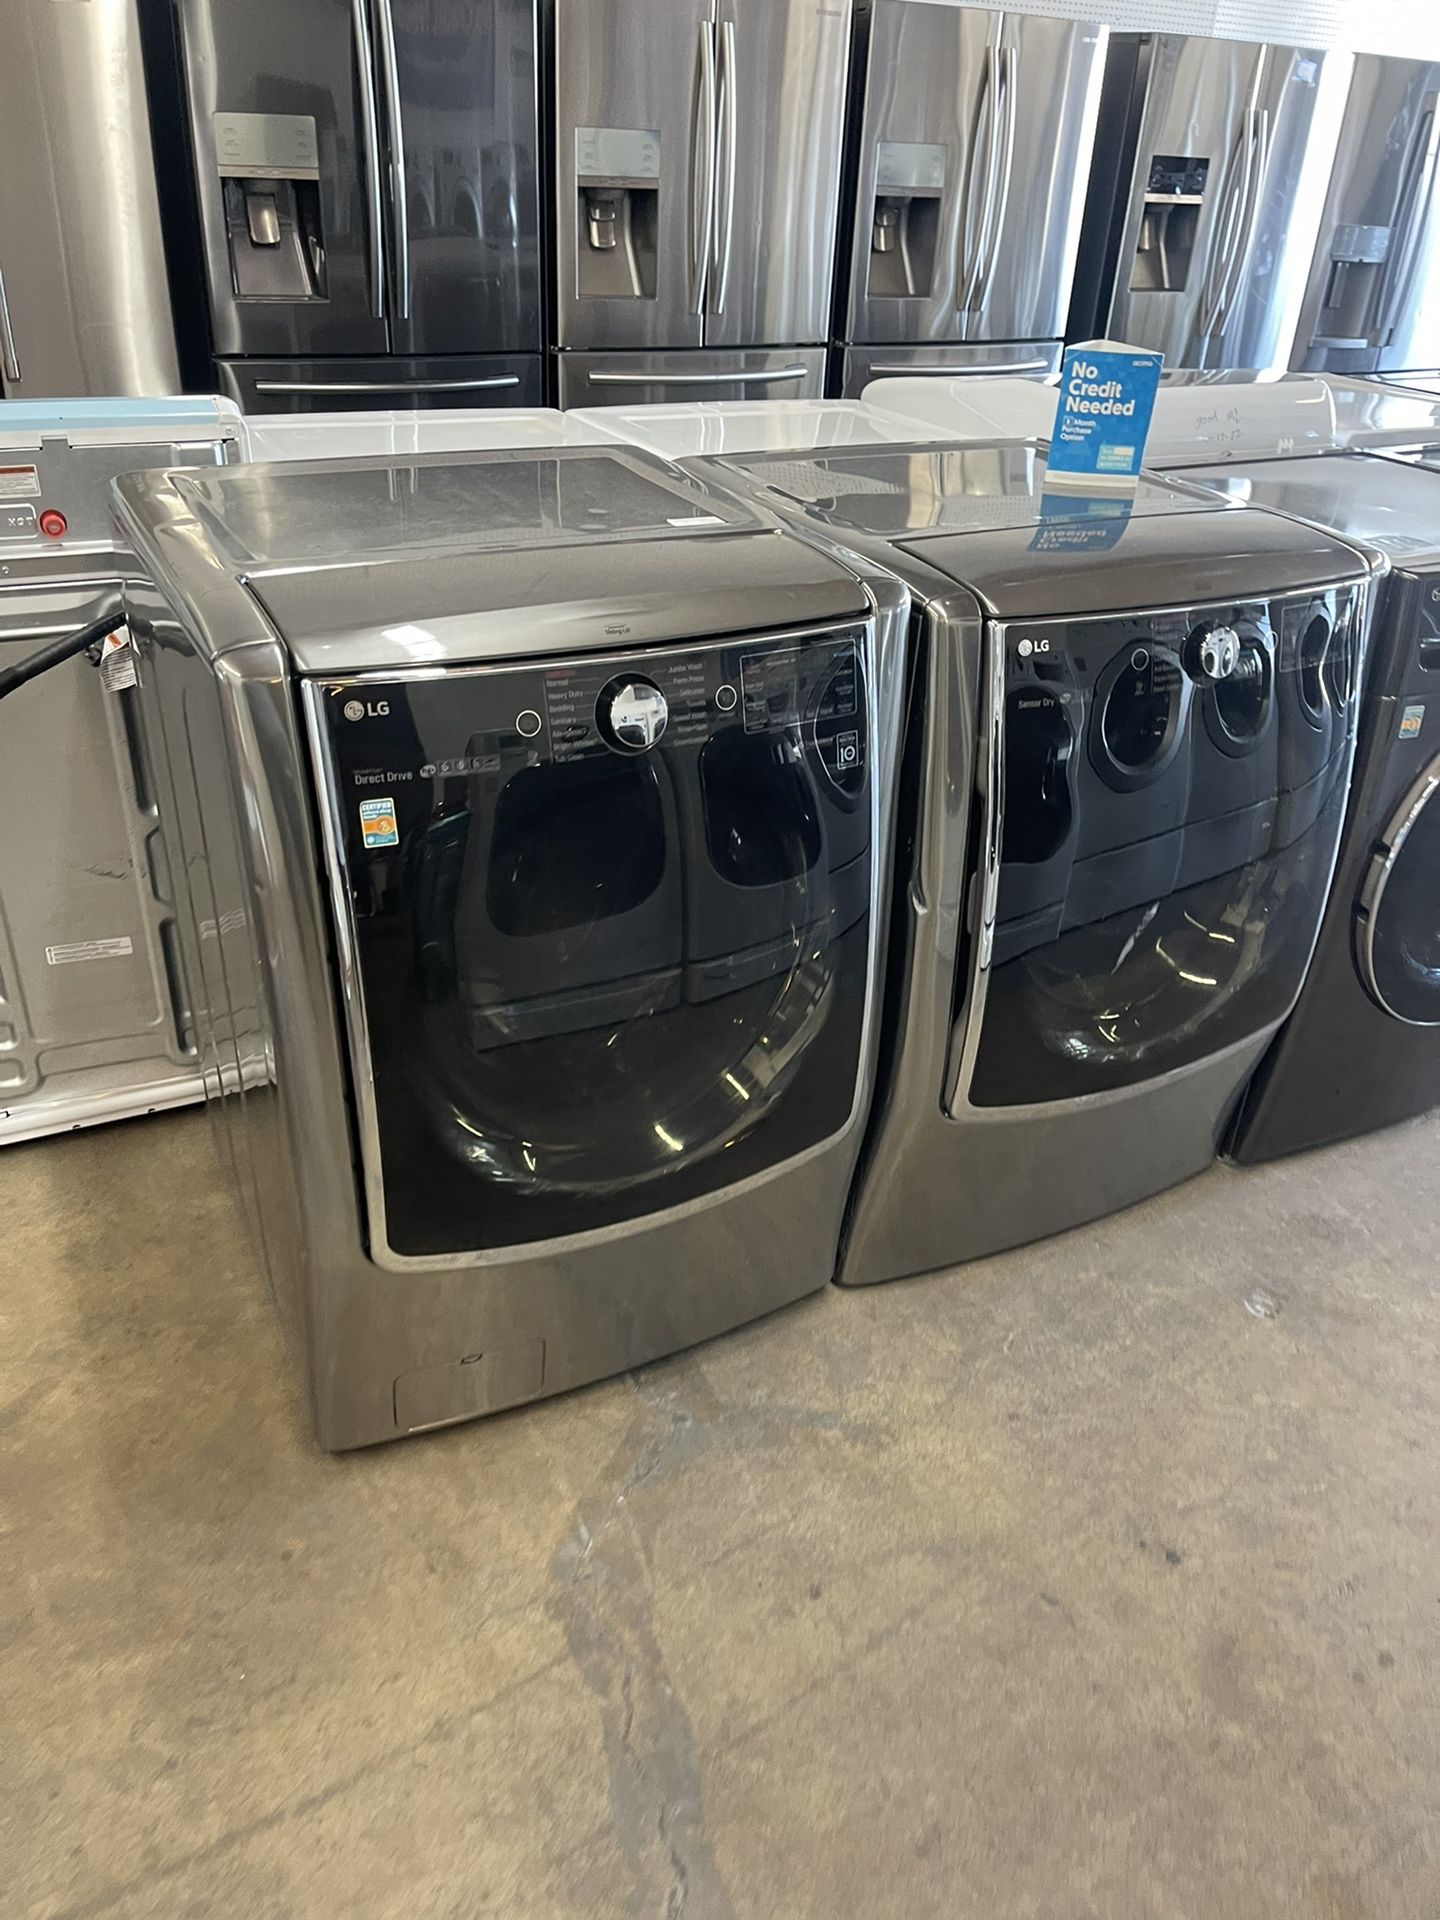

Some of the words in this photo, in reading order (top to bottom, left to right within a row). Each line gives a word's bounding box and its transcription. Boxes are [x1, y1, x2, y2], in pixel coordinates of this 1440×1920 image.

[1071, 361, 1098, 379] No
[1068, 379, 1122, 398] Credit
[1065, 395, 1135, 416] Needed
[1074, 418, 1096, 428] Month
[1061, 426, 1092, 434] Purchase
[1060, 433, 1085, 441] Option
[1034, 640, 1050, 652] LG
[367, 701, 390, 716] LG
[1043, 698, 1055, 706] Dry
[355, 774, 385, 785] Direct
[387, 771, 413, 782] Drive
